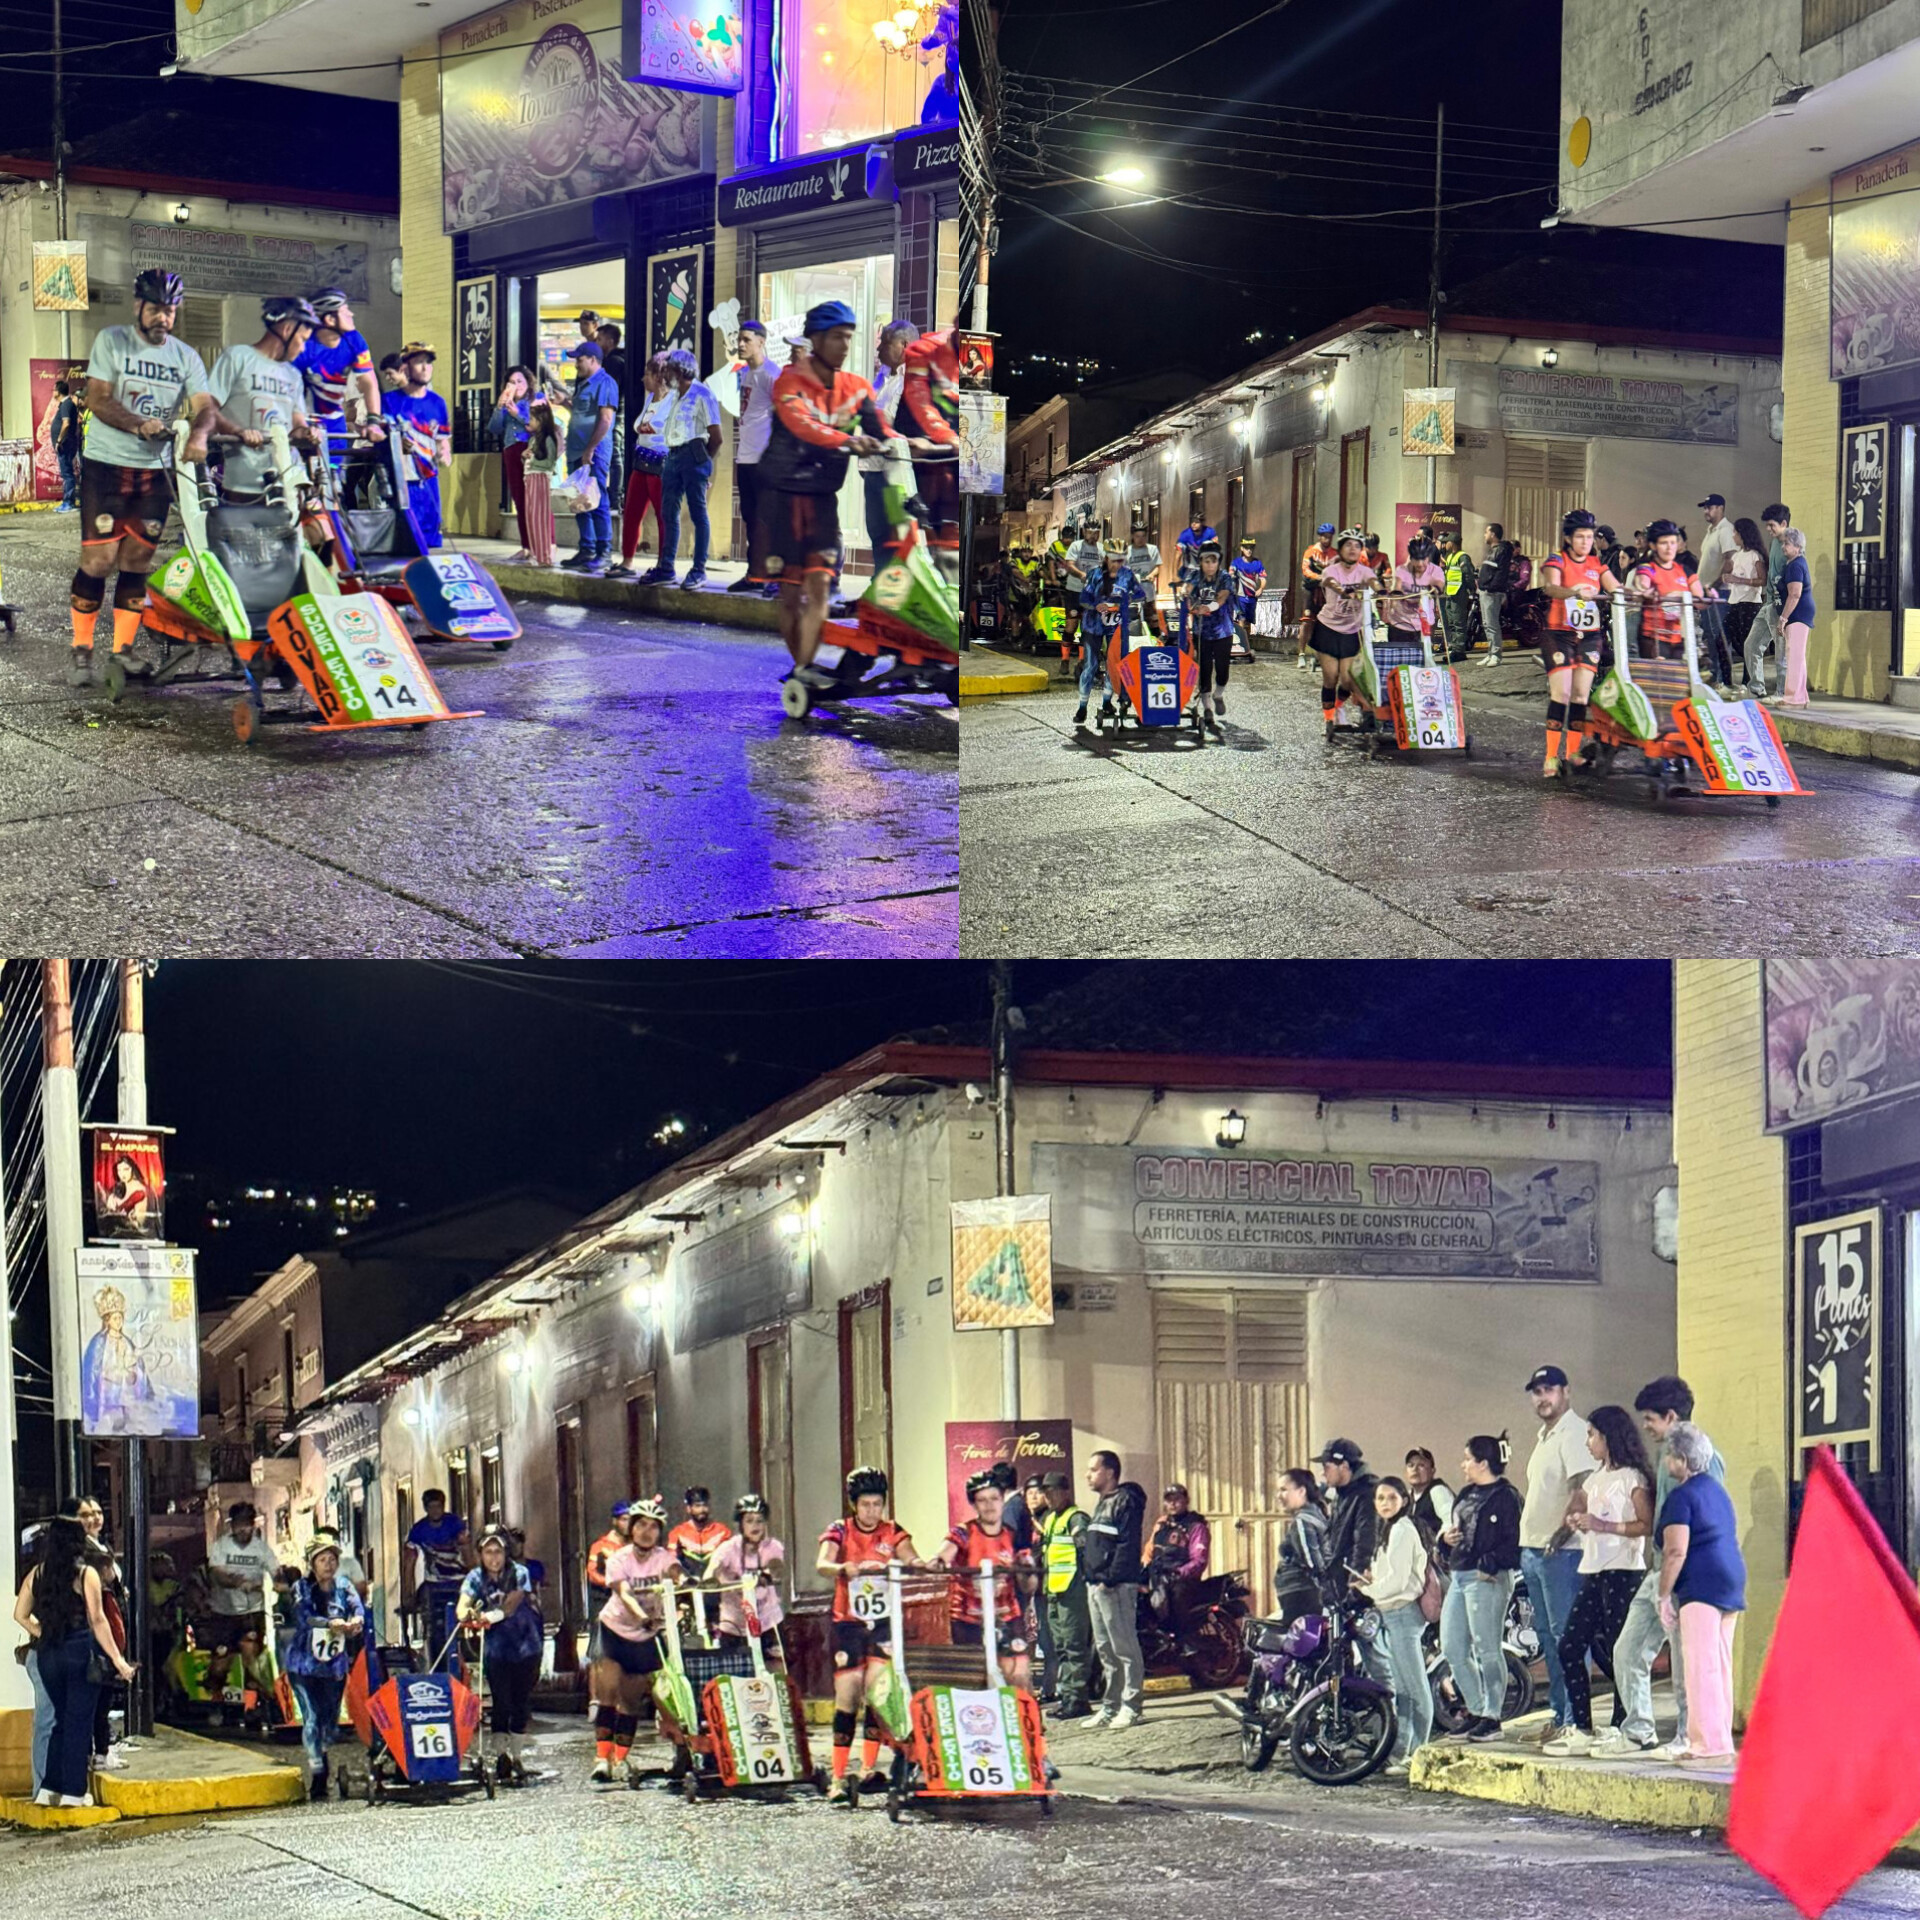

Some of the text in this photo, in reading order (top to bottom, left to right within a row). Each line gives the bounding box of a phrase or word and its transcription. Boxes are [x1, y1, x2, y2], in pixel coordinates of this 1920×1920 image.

[461, 15, 509, 50] Panadería
[913, 143, 959, 170] Pizze
[1856, 157, 1909, 193] Panadería
[734, 174, 824, 209] Restaurante
[132, 224, 250, 255] COMERCIAL
[467, 284, 489, 320] 15
[65, 366, 87, 381] Tova
[467, 348, 476, 380] 1
[1499, 370, 1684, 404] COMERCIAL TOVAR
[1556, 400, 1605, 412] MATERIALES
[1605, 403, 1615, 411] DE
[1855, 431, 1880, 471] 15
[1852, 460, 1883, 483] Panes
[1429, 510, 1456, 525] Tovar
[1854, 499, 1864, 532] 1
[438, 564, 469, 580] 23
[299, 603, 336, 656] SUPER
[1105, 612, 1122, 623] 16
[1571, 609, 1594, 627] 05
[277, 607, 340, 719] TOVAR
[325, 656, 364, 711] EXITO
[374, 685, 417, 709] 14
[1151, 692, 1173, 706] 16
[1422, 730, 1446, 746] 04
[1678, 704, 1720, 782] TOVAR
[1743, 770, 1771, 787] 05
[101, 1143, 159, 1153] EL AMPARO
[1135, 1156, 1493, 1208] COMERCIAL TOVAR
[1148, 1206, 1479, 1230] FERRETERÍA, MATERIALES DE CONSTRUCCIÓN,
[1141, 1225, 1487, 1248] ARTÍCULOS ELÉCTRICOS, PINTURAS EN GENERAL
[1817, 1227, 1864, 1304] 15
[1814, 1284, 1872, 1331] Panes
[1819, 1360, 1838, 1425] 1
[954, 1444, 992, 1463] Feria
[1005, 1432, 1060, 1462] Tovar
[854, 1593, 886, 1616] 05
[315, 1639, 340, 1658] 16
[418, 1735, 447, 1754] 16
[754, 1758, 785, 1778] 04
[969, 1767, 1003, 1785] 05
